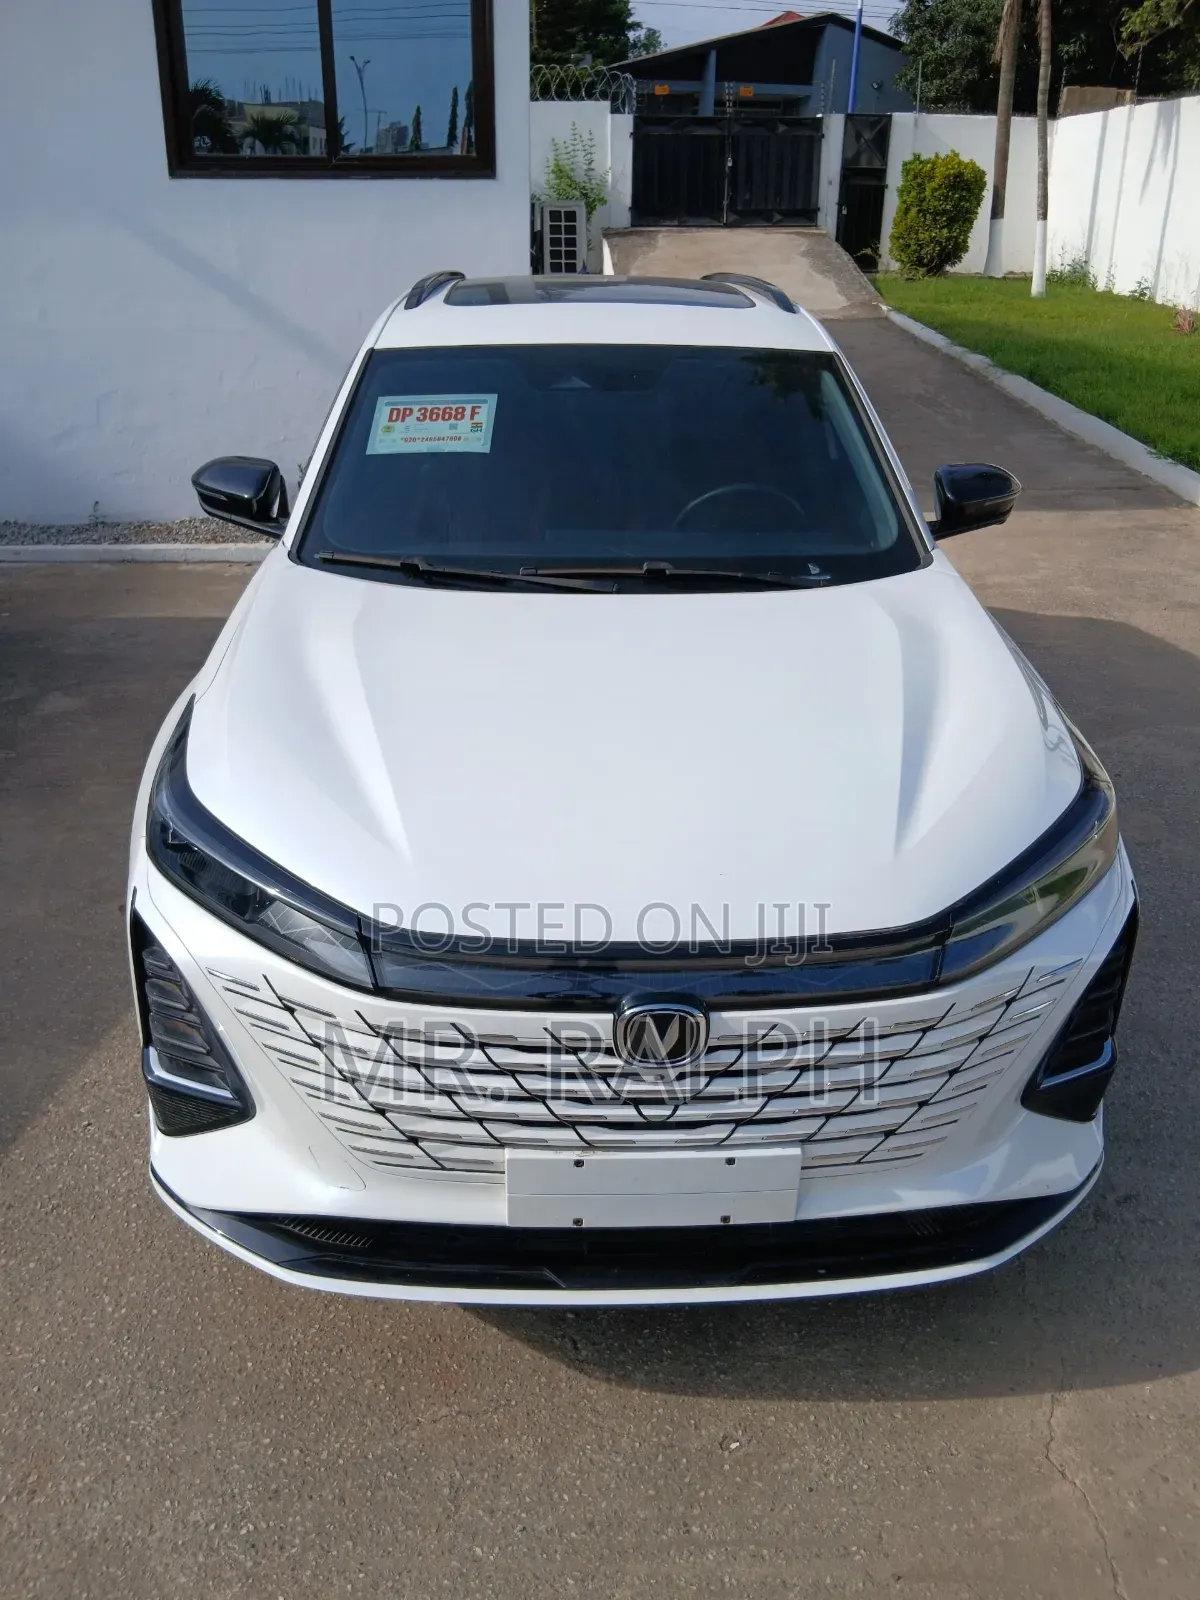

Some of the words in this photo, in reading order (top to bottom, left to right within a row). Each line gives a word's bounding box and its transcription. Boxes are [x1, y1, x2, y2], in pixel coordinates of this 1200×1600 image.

[387, 407, 414, 423] DP
[416, 406, 467, 423] 3668
[469, 405, 482, 421] F
